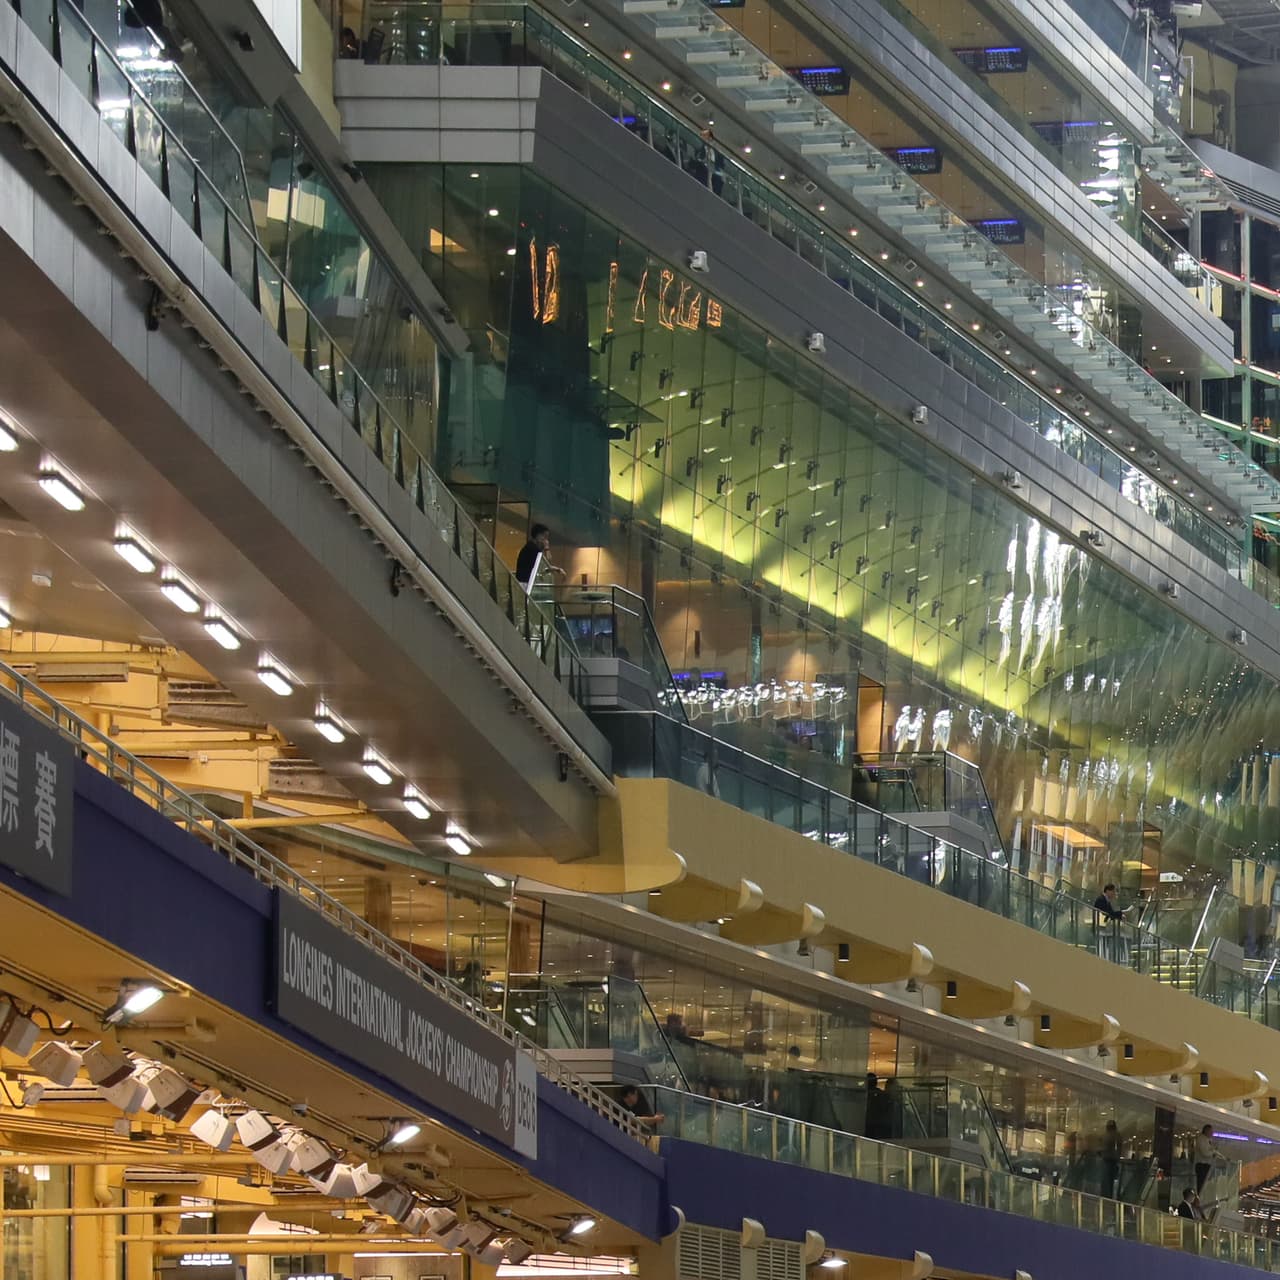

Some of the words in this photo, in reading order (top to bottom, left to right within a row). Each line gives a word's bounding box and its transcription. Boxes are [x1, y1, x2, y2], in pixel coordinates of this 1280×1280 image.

[283, 927, 334, 1011] LONGINES
[336, 962, 404, 1053] INTERNATIONAL
[406, 1009, 444, 1077] JOCKEYS'
[445, 1034, 499, 1108] CHAMPIONSHIP
